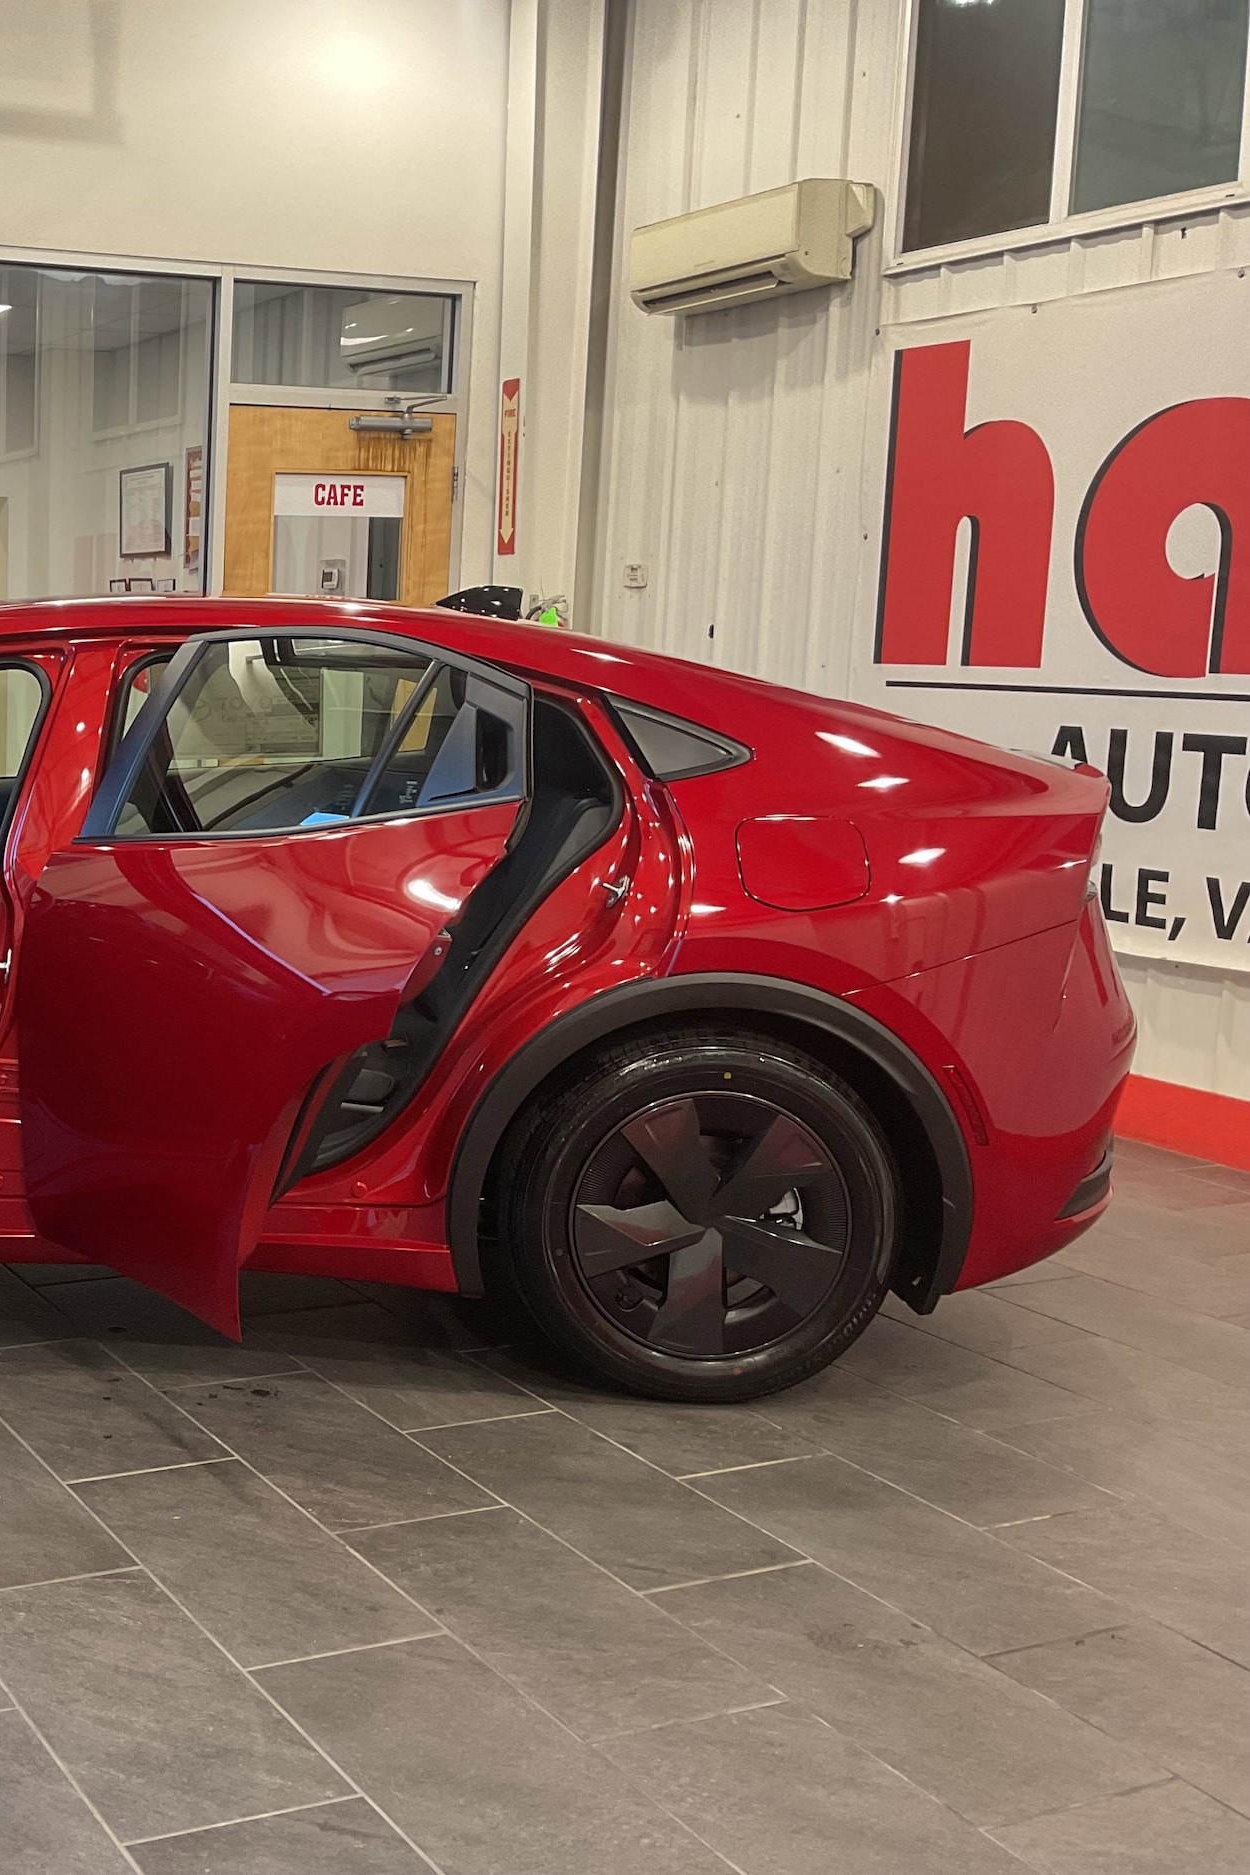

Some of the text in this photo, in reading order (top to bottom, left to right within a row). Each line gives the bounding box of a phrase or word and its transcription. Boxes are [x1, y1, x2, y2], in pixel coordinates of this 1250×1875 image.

[505, 409, 516, 418] FIRE
[314, 483, 364, 506] CAFE
[1051, 725, 1250, 830] UT
[1206, 877, 1250, 943] V
